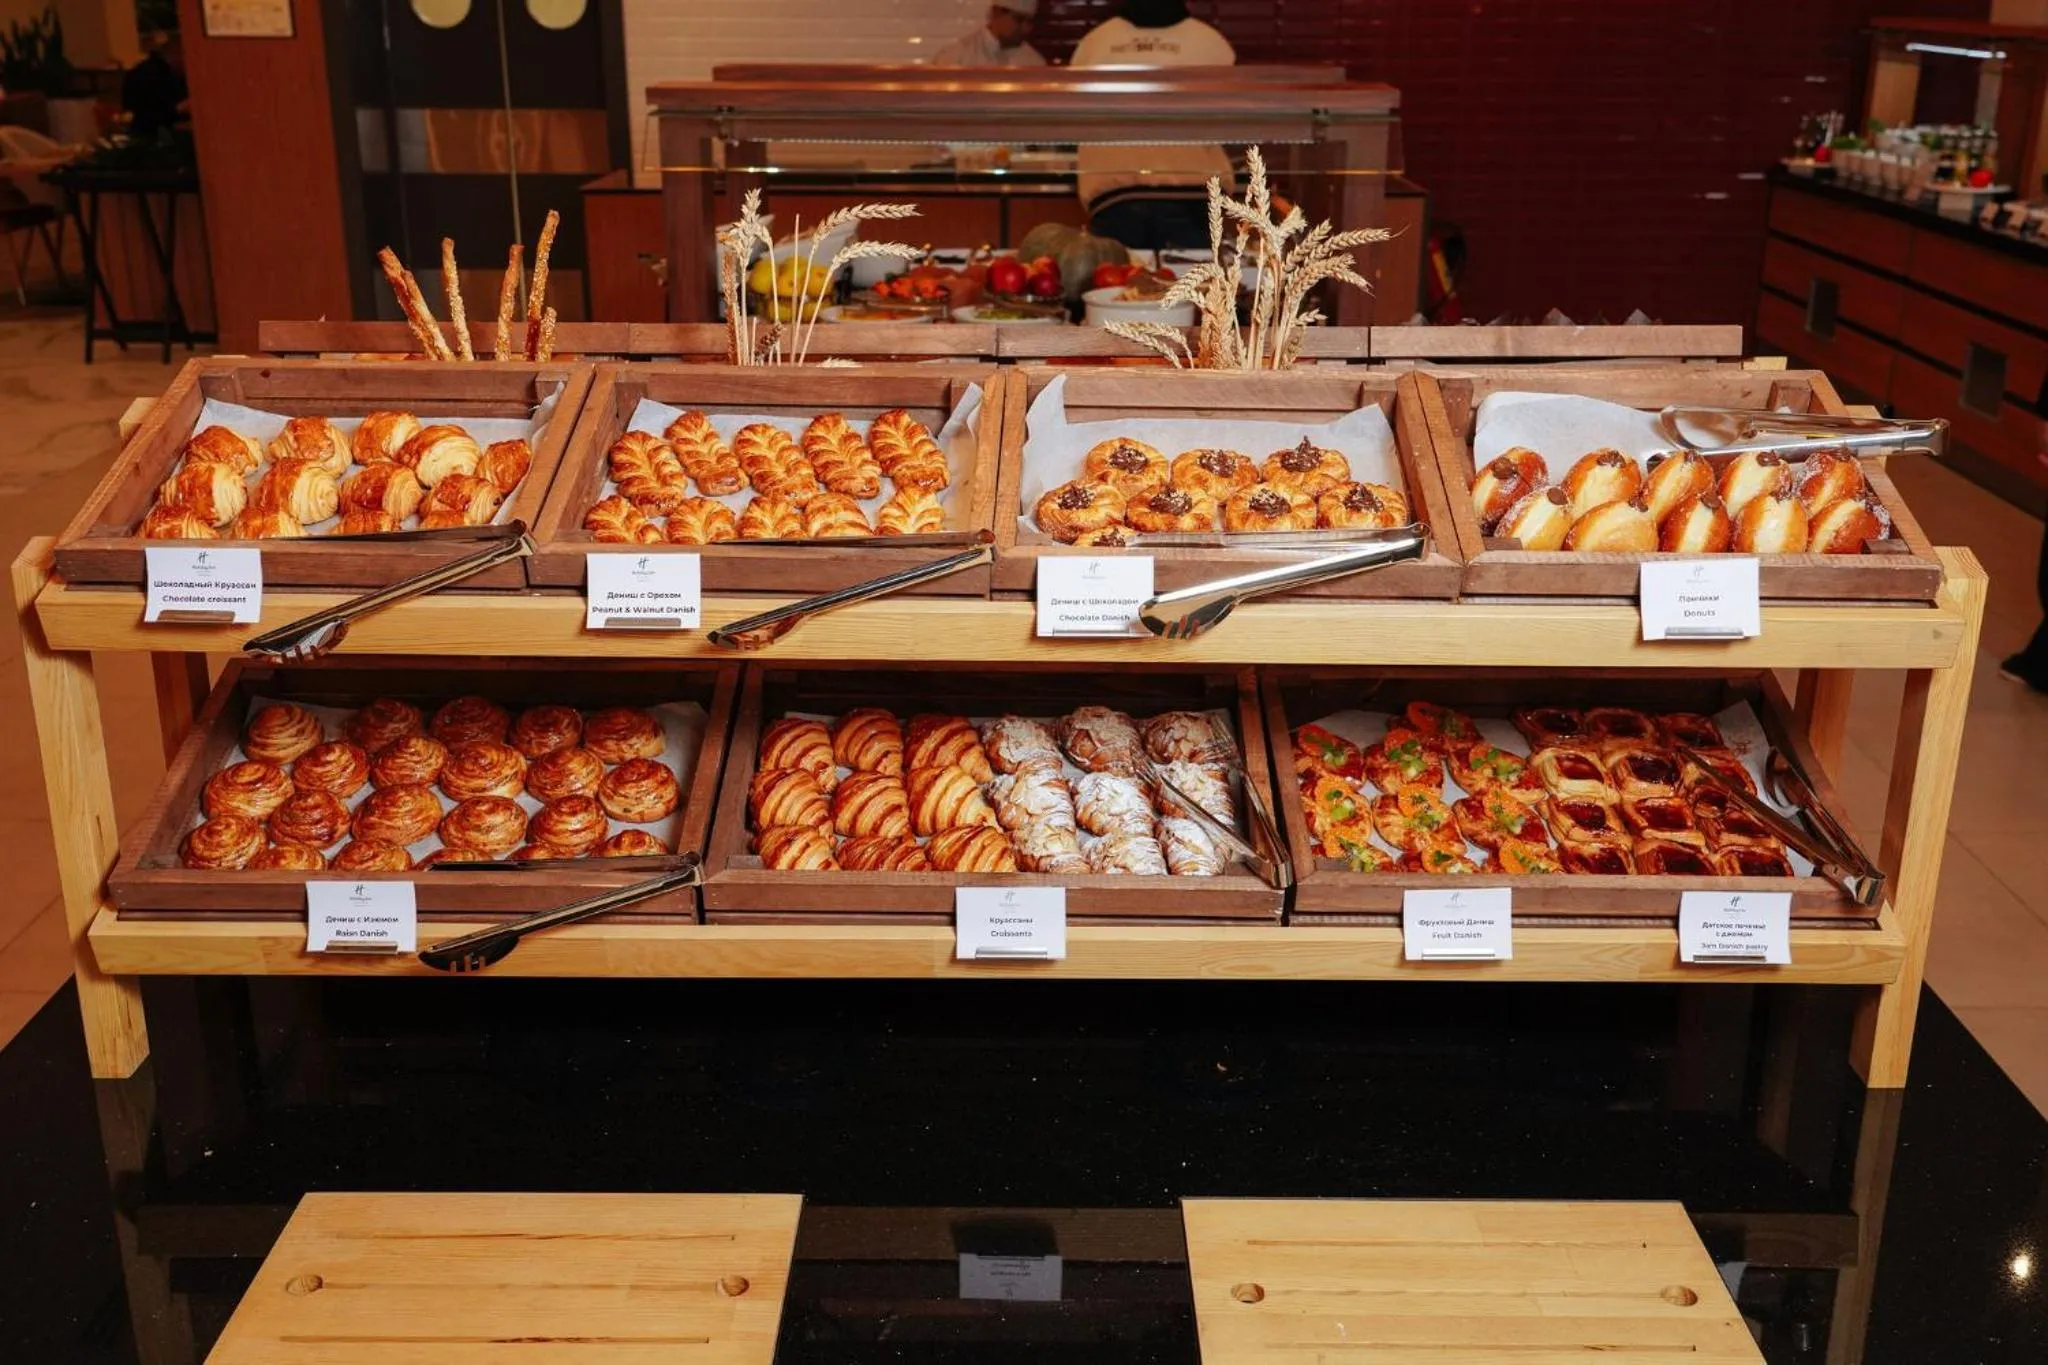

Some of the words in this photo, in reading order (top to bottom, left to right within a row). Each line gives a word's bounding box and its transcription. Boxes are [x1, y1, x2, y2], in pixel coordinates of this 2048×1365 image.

[153, 580, 213, 589] Шоколадный
[162, 594, 206, 603] Chocolate
[207, 594, 247, 603] croissant
[592, 606, 623, 614] Peanut
[625, 606, 631, 614] &
[633, 606, 664, 614] Walnut
[666, 606, 697, 614] Danish
[1684, 609, 1717, 618] Donuts
[1059, 614, 1100, 622] Chocolate
[1101, 614, 1131, 622] Danish
[360, 929, 389, 937] Danish
[1453, 931, 1482, 939] Danish
